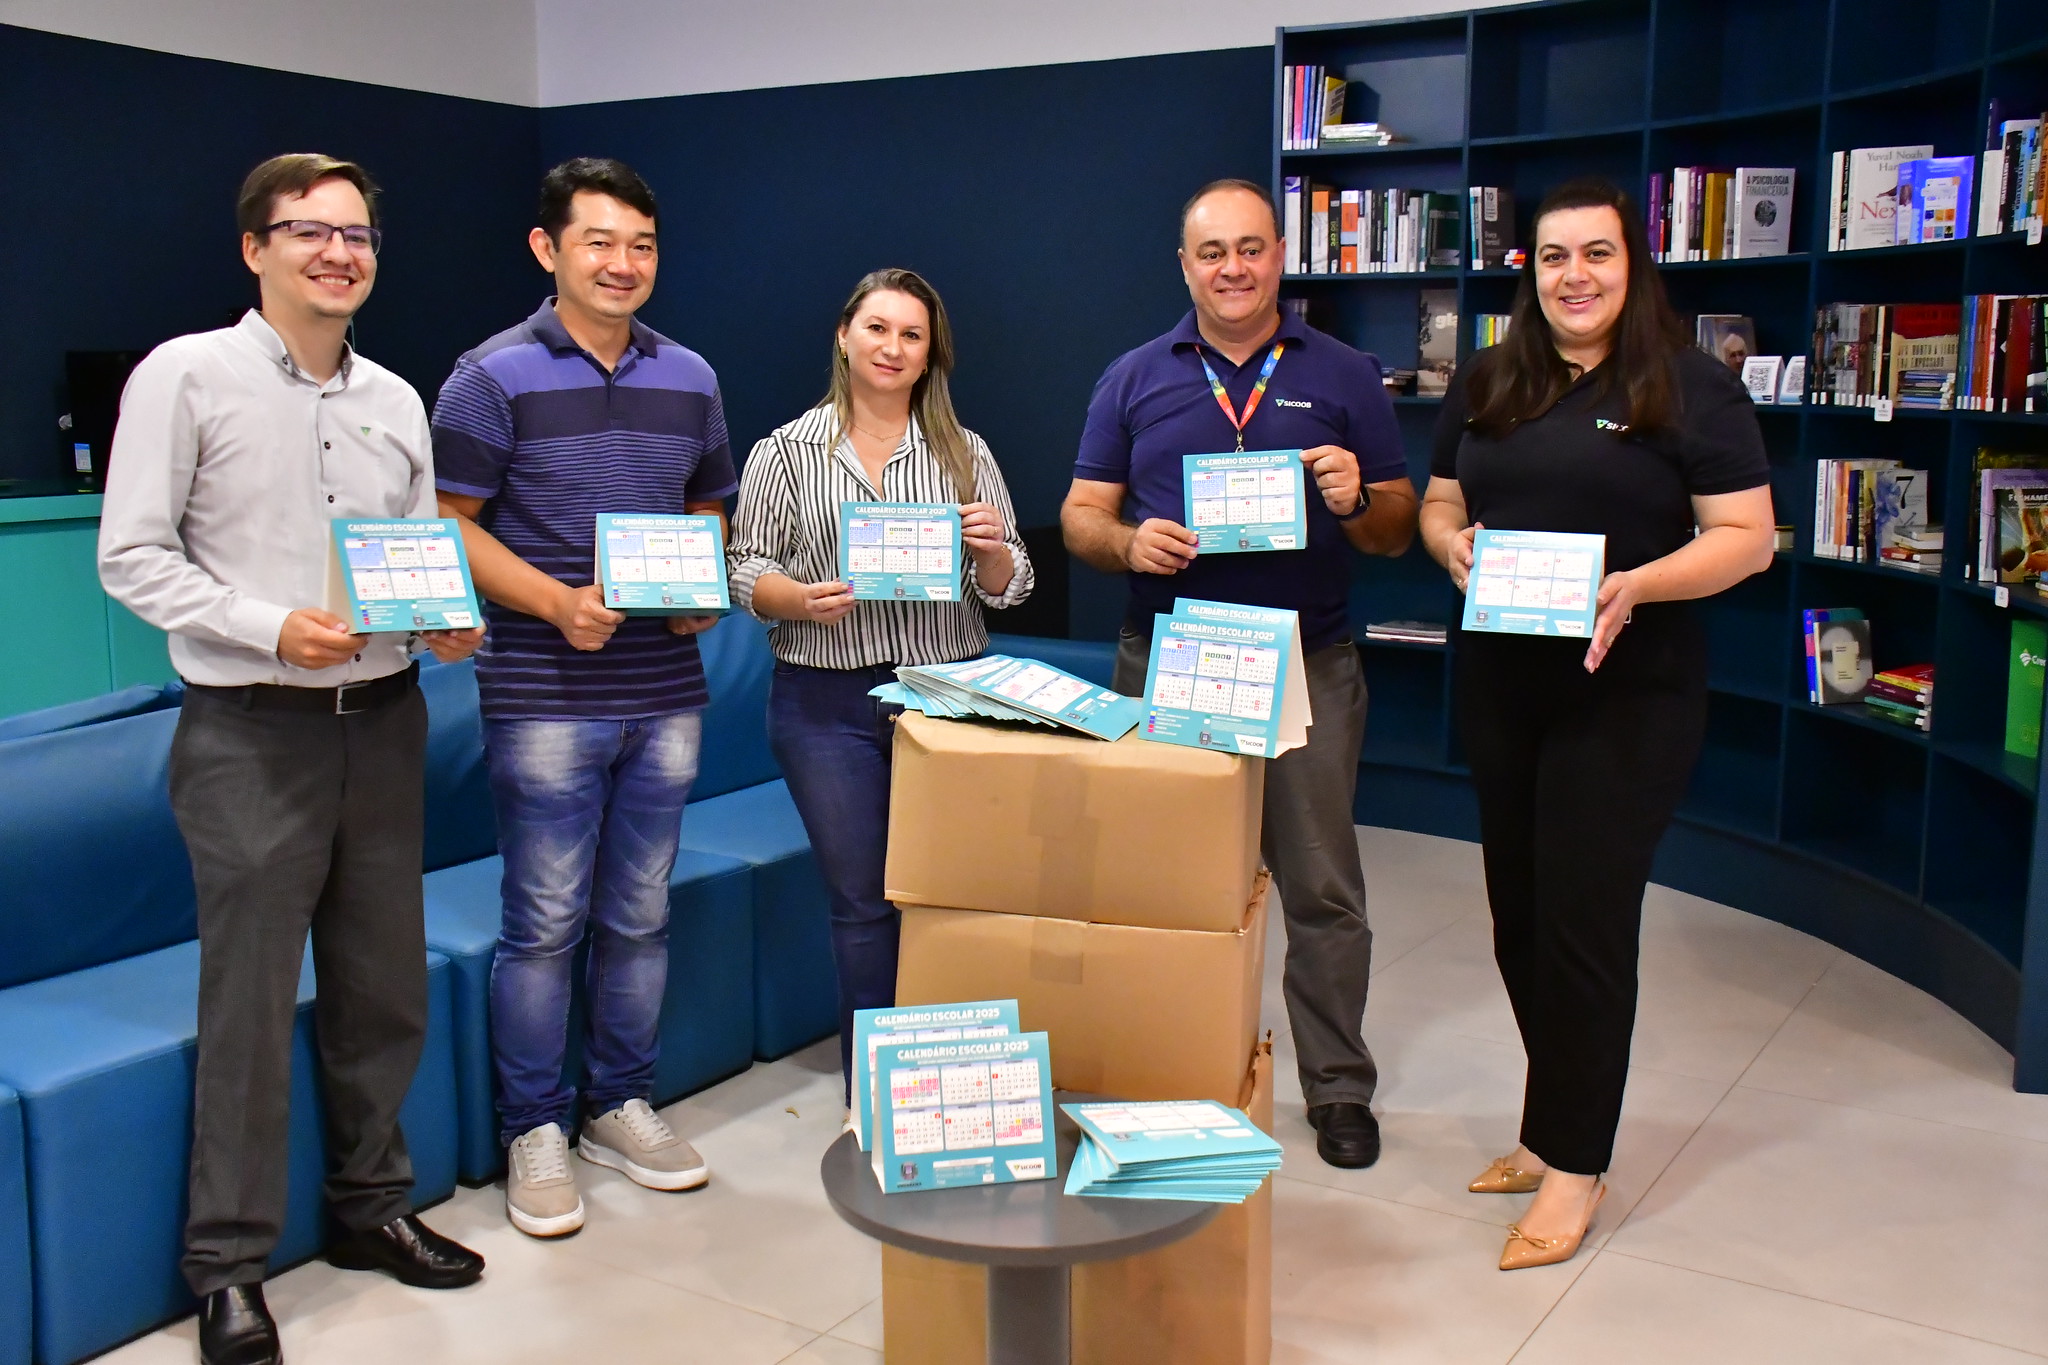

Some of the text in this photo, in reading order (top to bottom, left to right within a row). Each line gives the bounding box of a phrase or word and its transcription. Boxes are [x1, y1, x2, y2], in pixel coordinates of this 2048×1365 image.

[1867, 149, 1923, 162] Yuval Noah
[1879, 162, 1899, 173] Har
[1746, 175, 1789, 184] A PSICOLOGIA
[1745, 184, 1789, 197] FINANCEIRA
[1283, 400, 1312, 409] SICOOB
[1196, 455, 1288, 466] CALENDÁRIO ESCOLAR 2025
[1896, 476, 1914, 509] 7
[855, 506, 896, 515] CALENDÁRIO
[897, 507, 928, 515] ESCOLAR
[347, 523, 446, 532] CALENDÁRIO ESCOLAR 2025
[611, 517, 654, 526] CALENDÁRIO
[687, 519, 706, 527] 2025
[1188, 605, 1229, 617] CALENDÁRIO
[1229, 610, 1261, 620] ESCOLAR
[1261, 613, 1281, 623] 2025
[1169, 622, 1217, 634] CALENDÁRIO
[1217, 626, 1252, 638] ESCOLAR
[1253, 630, 1275, 641] 2025
[874, 1011, 931, 1026] CALENDÁRIO
[932, 1009, 974, 1021] ESCOLAR
[975, 1007, 1000, 1018] 2025
[897, 1045, 957, 1060] CALENDÁRIO
[958, 1043, 1002, 1055] ESCOLAR
[1003, 1040, 1029, 1052] 2025
